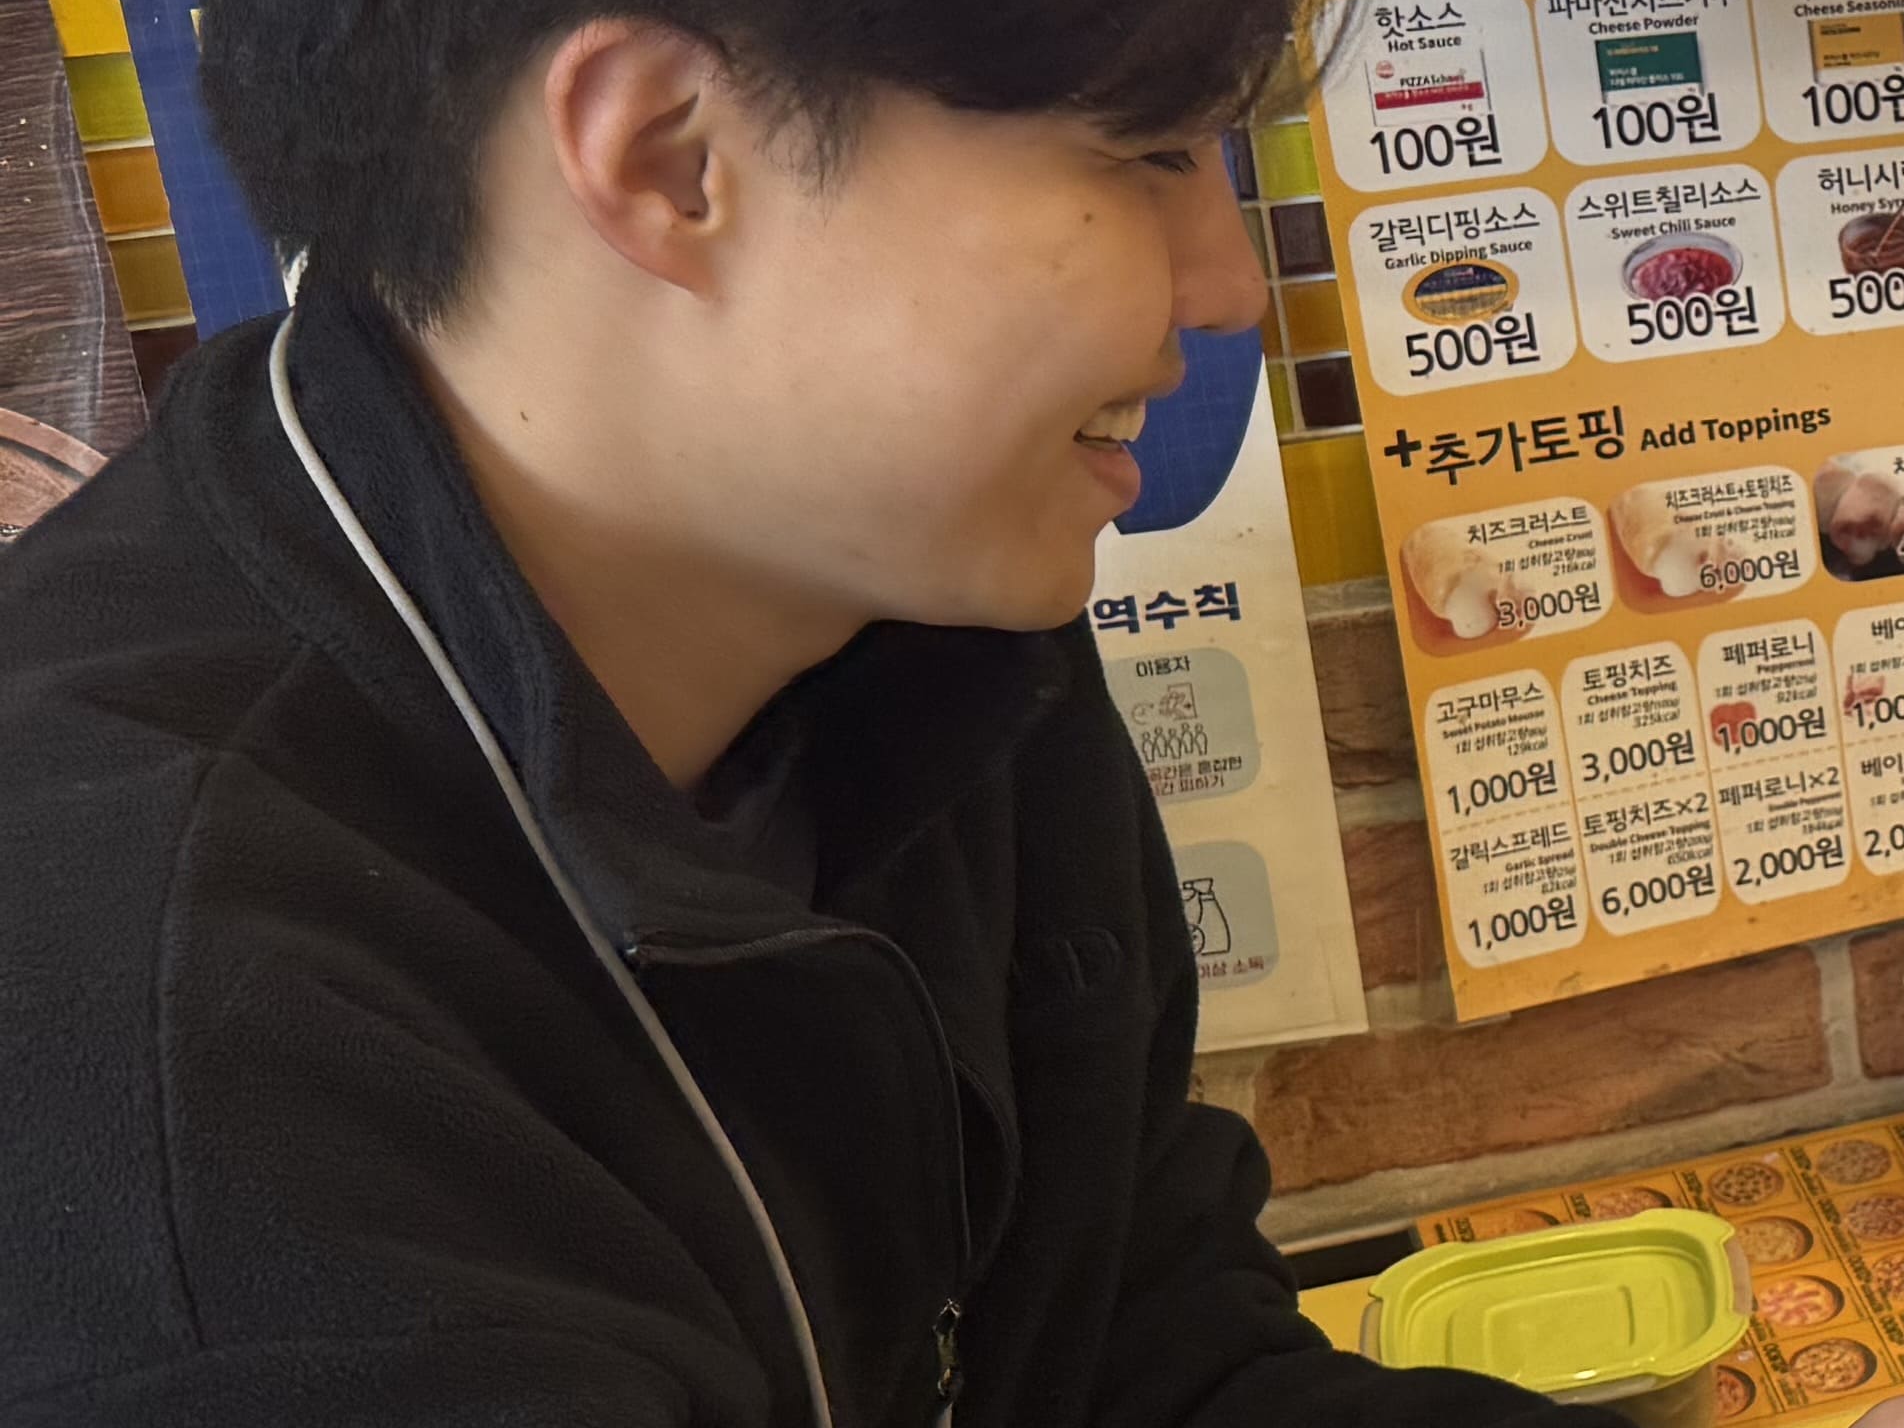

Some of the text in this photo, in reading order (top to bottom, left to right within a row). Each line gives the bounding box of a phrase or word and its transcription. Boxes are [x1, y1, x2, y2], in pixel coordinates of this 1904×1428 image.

[1374, 3, 1466, 39] 핫소스
[1588, 14, 1698, 36] Cheese Powder
[1794, 2, 1844, 18] Cheese
[1388, 35, 1461, 53] Hot Sauce
[1370, 114, 1502, 174] 100원
[1592, 94, 1722, 149] 100원
[1578, 178, 1760, 221] 스위트칠리소스
[1831, 198, 1875, 215] Honey
[1370, 202, 1540, 253] 갈릭디핑소스
[1612, 215, 1736, 240] Sweet Chili Sauce
[1384, 239, 1533, 270] Garlic Dipping Sauce
[1628, 286, 1759, 345] 500원
[1406, 312, 1540, 377] 500원
[1641, 423, 1695, 451] Add
[1700, 403, 1831, 442] Toppings
[1468, 505, 1592, 545] 치즈크러스트
[1093, 581, 1241, 634] 역수칙
[1499, 582, 1601, 629] 3,000원
[1136, 655, 1190, 677] 이용자
[1723, 633, 1814, 665] 페퍼로니
[1583, 655, 1675, 692] 토핑치즈
[1436, 682, 1544, 724] 고구마무스
[1718, 707, 1827, 755] 1,000원
[1582, 730, 1695, 784] 3,000원
[1448, 760, 1557, 816] 1,000원
[1450, 822, 1571, 870] 갈릭스프레드
[1734, 835, 1845, 888] 2,000원
[1602, 864, 1715, 917] 6,000원
